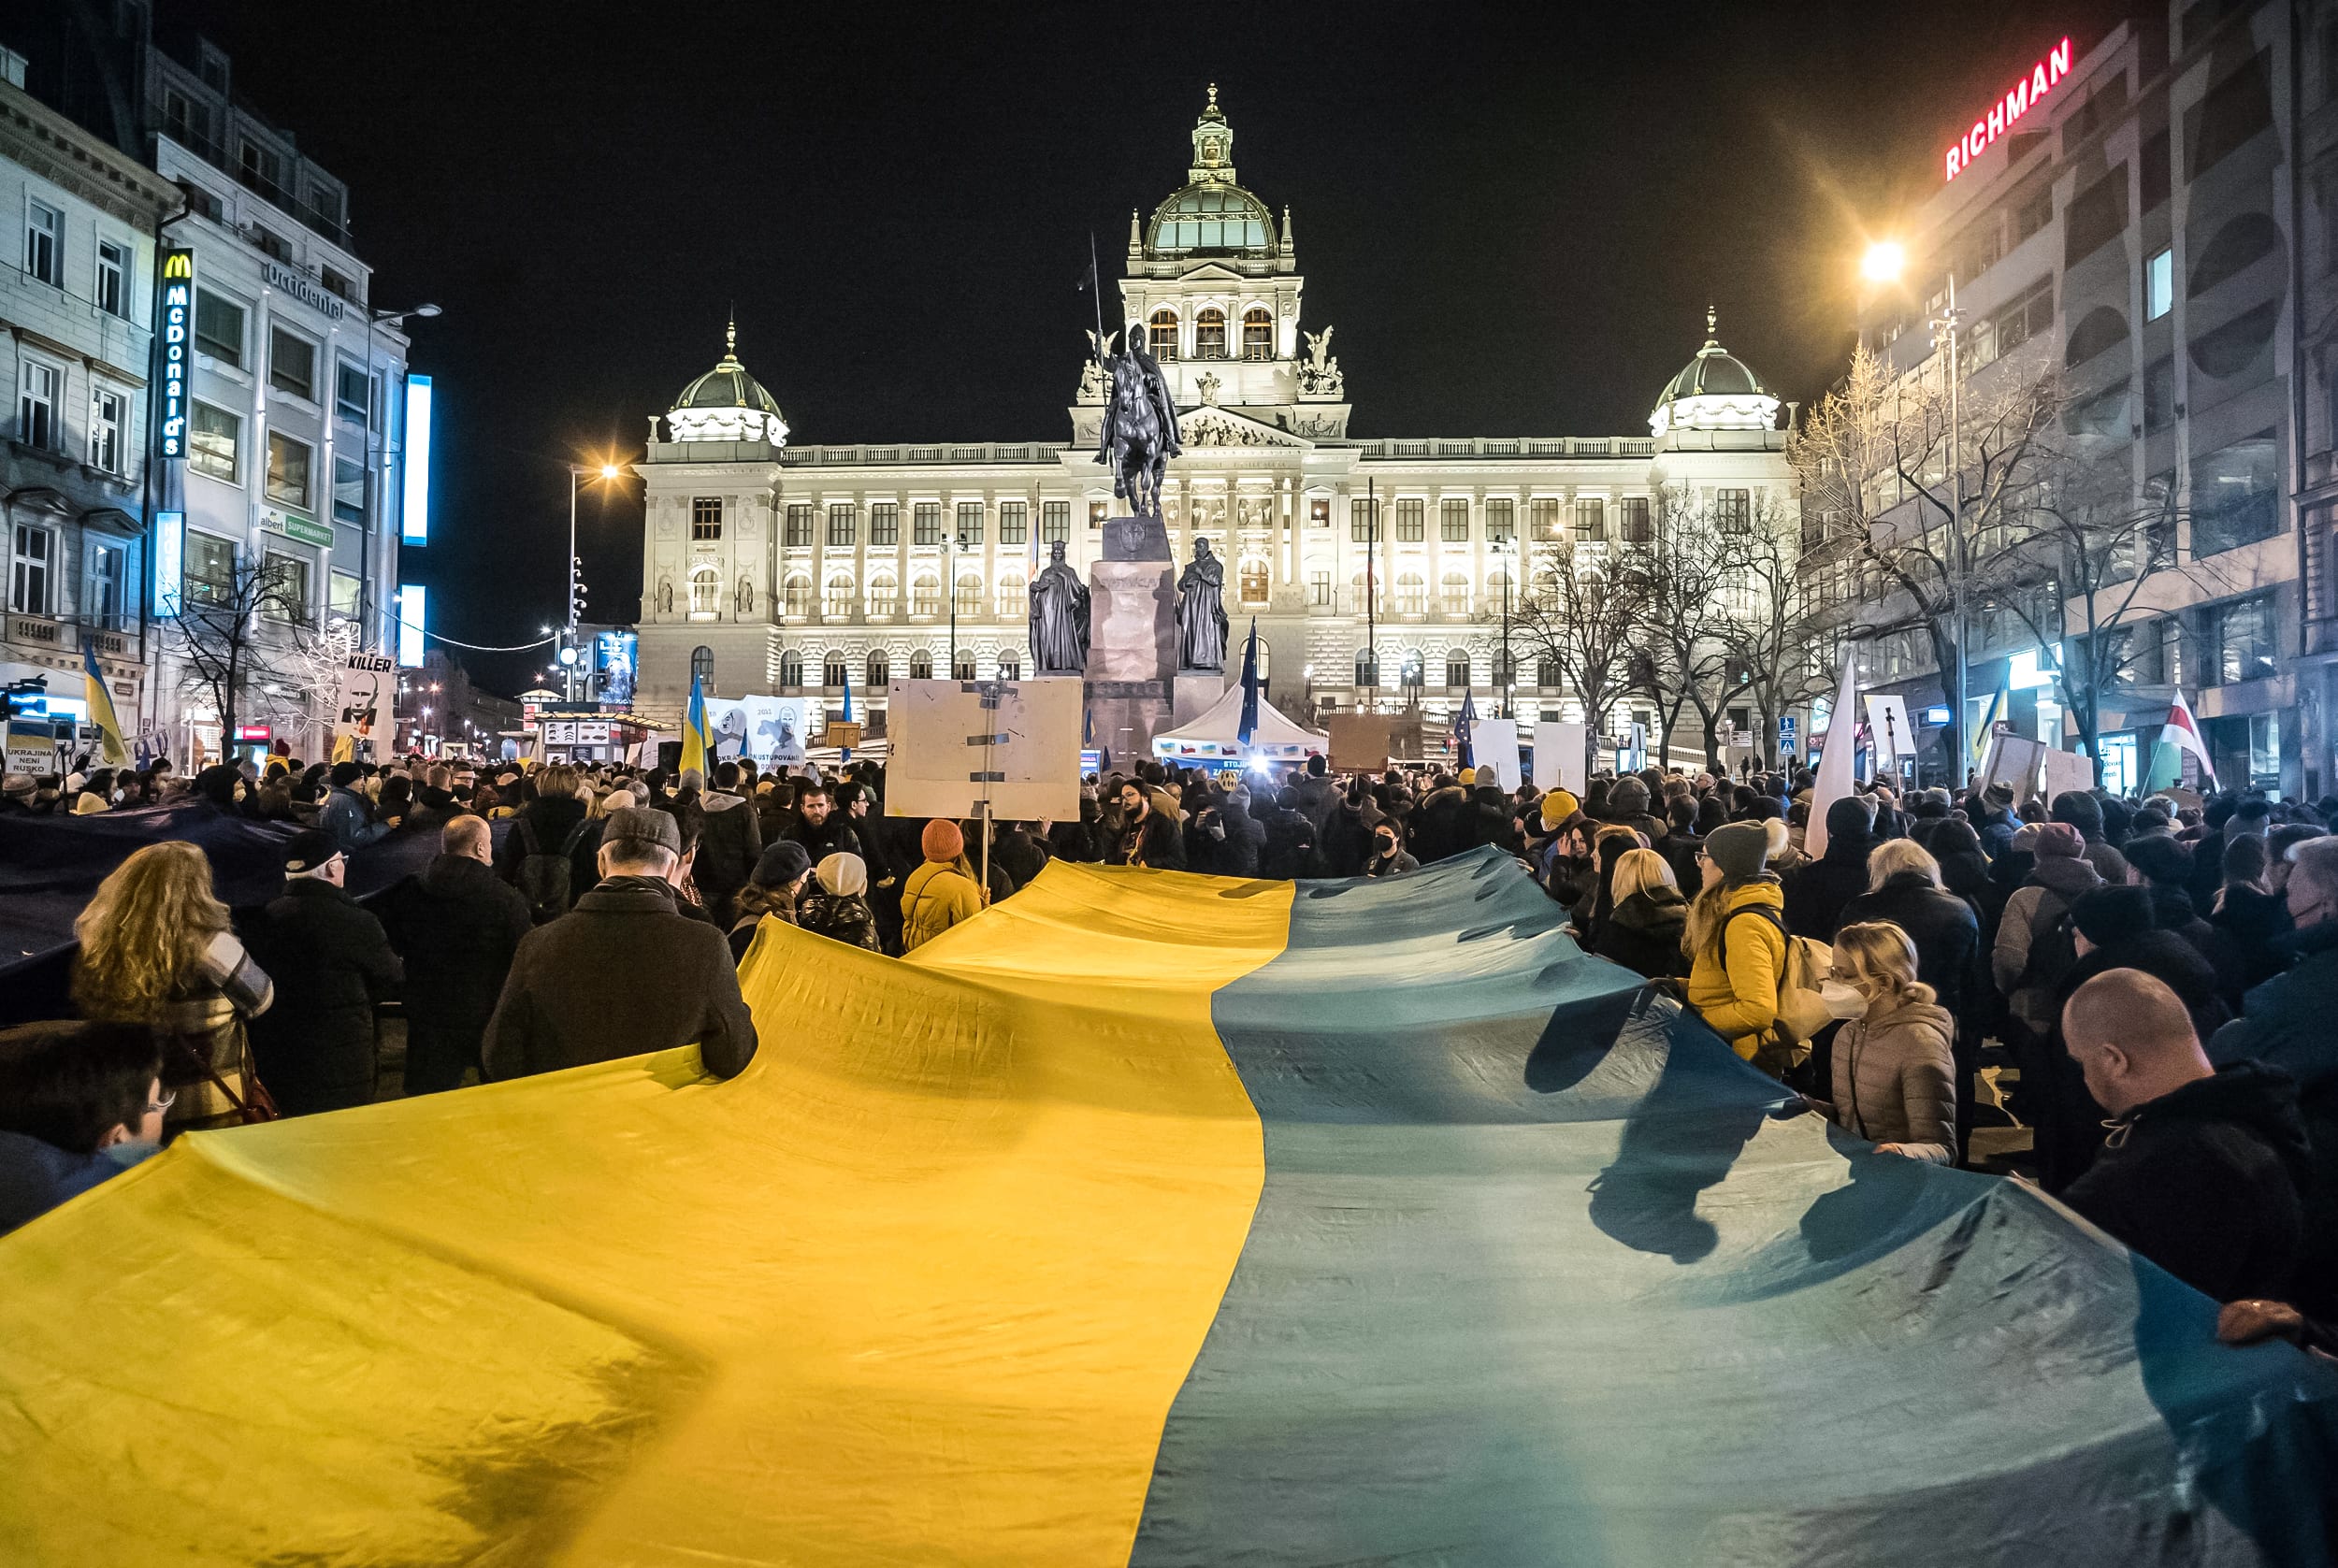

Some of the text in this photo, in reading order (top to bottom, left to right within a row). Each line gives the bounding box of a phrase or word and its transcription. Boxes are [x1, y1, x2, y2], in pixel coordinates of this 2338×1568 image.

[1946, 37, 2070, 181] RICHMAN
[268, 264, 345, 322] Occidental
[163, 285, 188, 455] McDonald's
[260, 516, 331, 542] albert SUPERMARKET
[348, 655, 392, 672] KILLER
[7, 748, 52, 756] UKRAJINA
